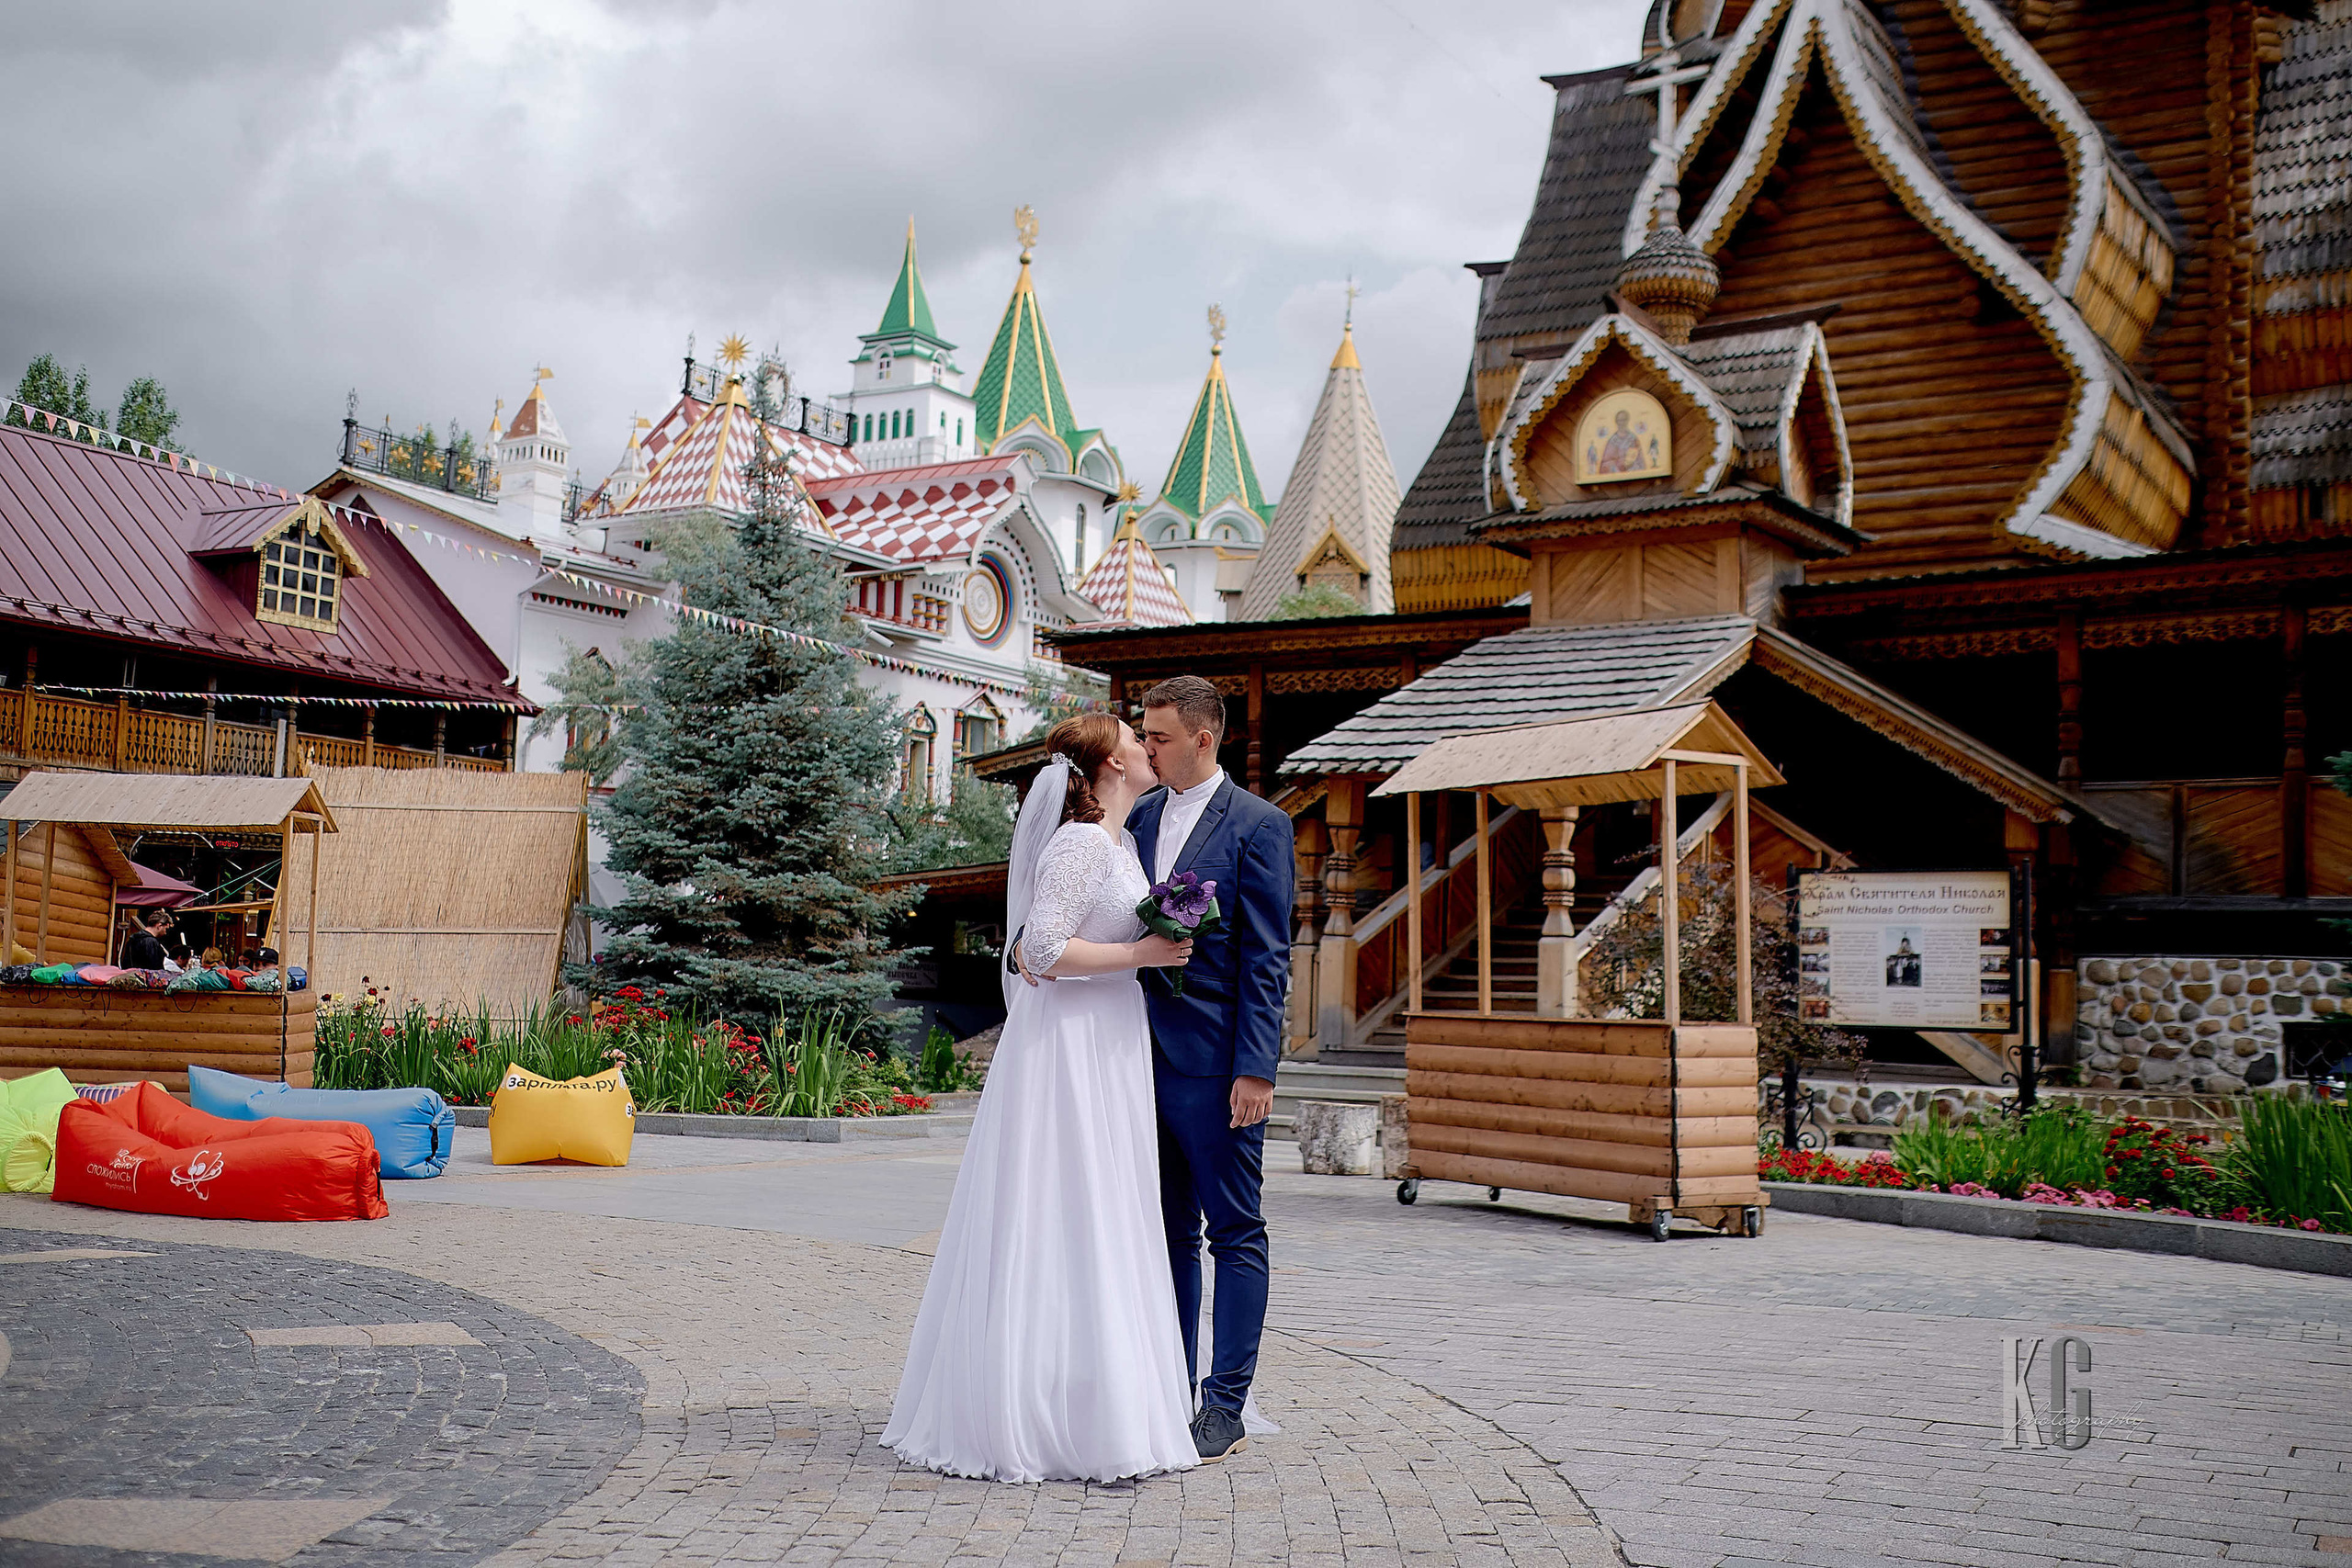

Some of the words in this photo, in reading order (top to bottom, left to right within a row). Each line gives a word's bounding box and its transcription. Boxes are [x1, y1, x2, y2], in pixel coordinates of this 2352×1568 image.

[1804, 886, 1846, 902] Храм
[1850, 886, 1936, 899] Святителя
[1941, 886, 2006, 899] Николая
[1817, 905, 1844, 915] Saint
[1847, 905, 1894, 915] Nicholas
[1897, 904, 1949, 915] Orthodox
[1952, 904, 1995, 915] Church
